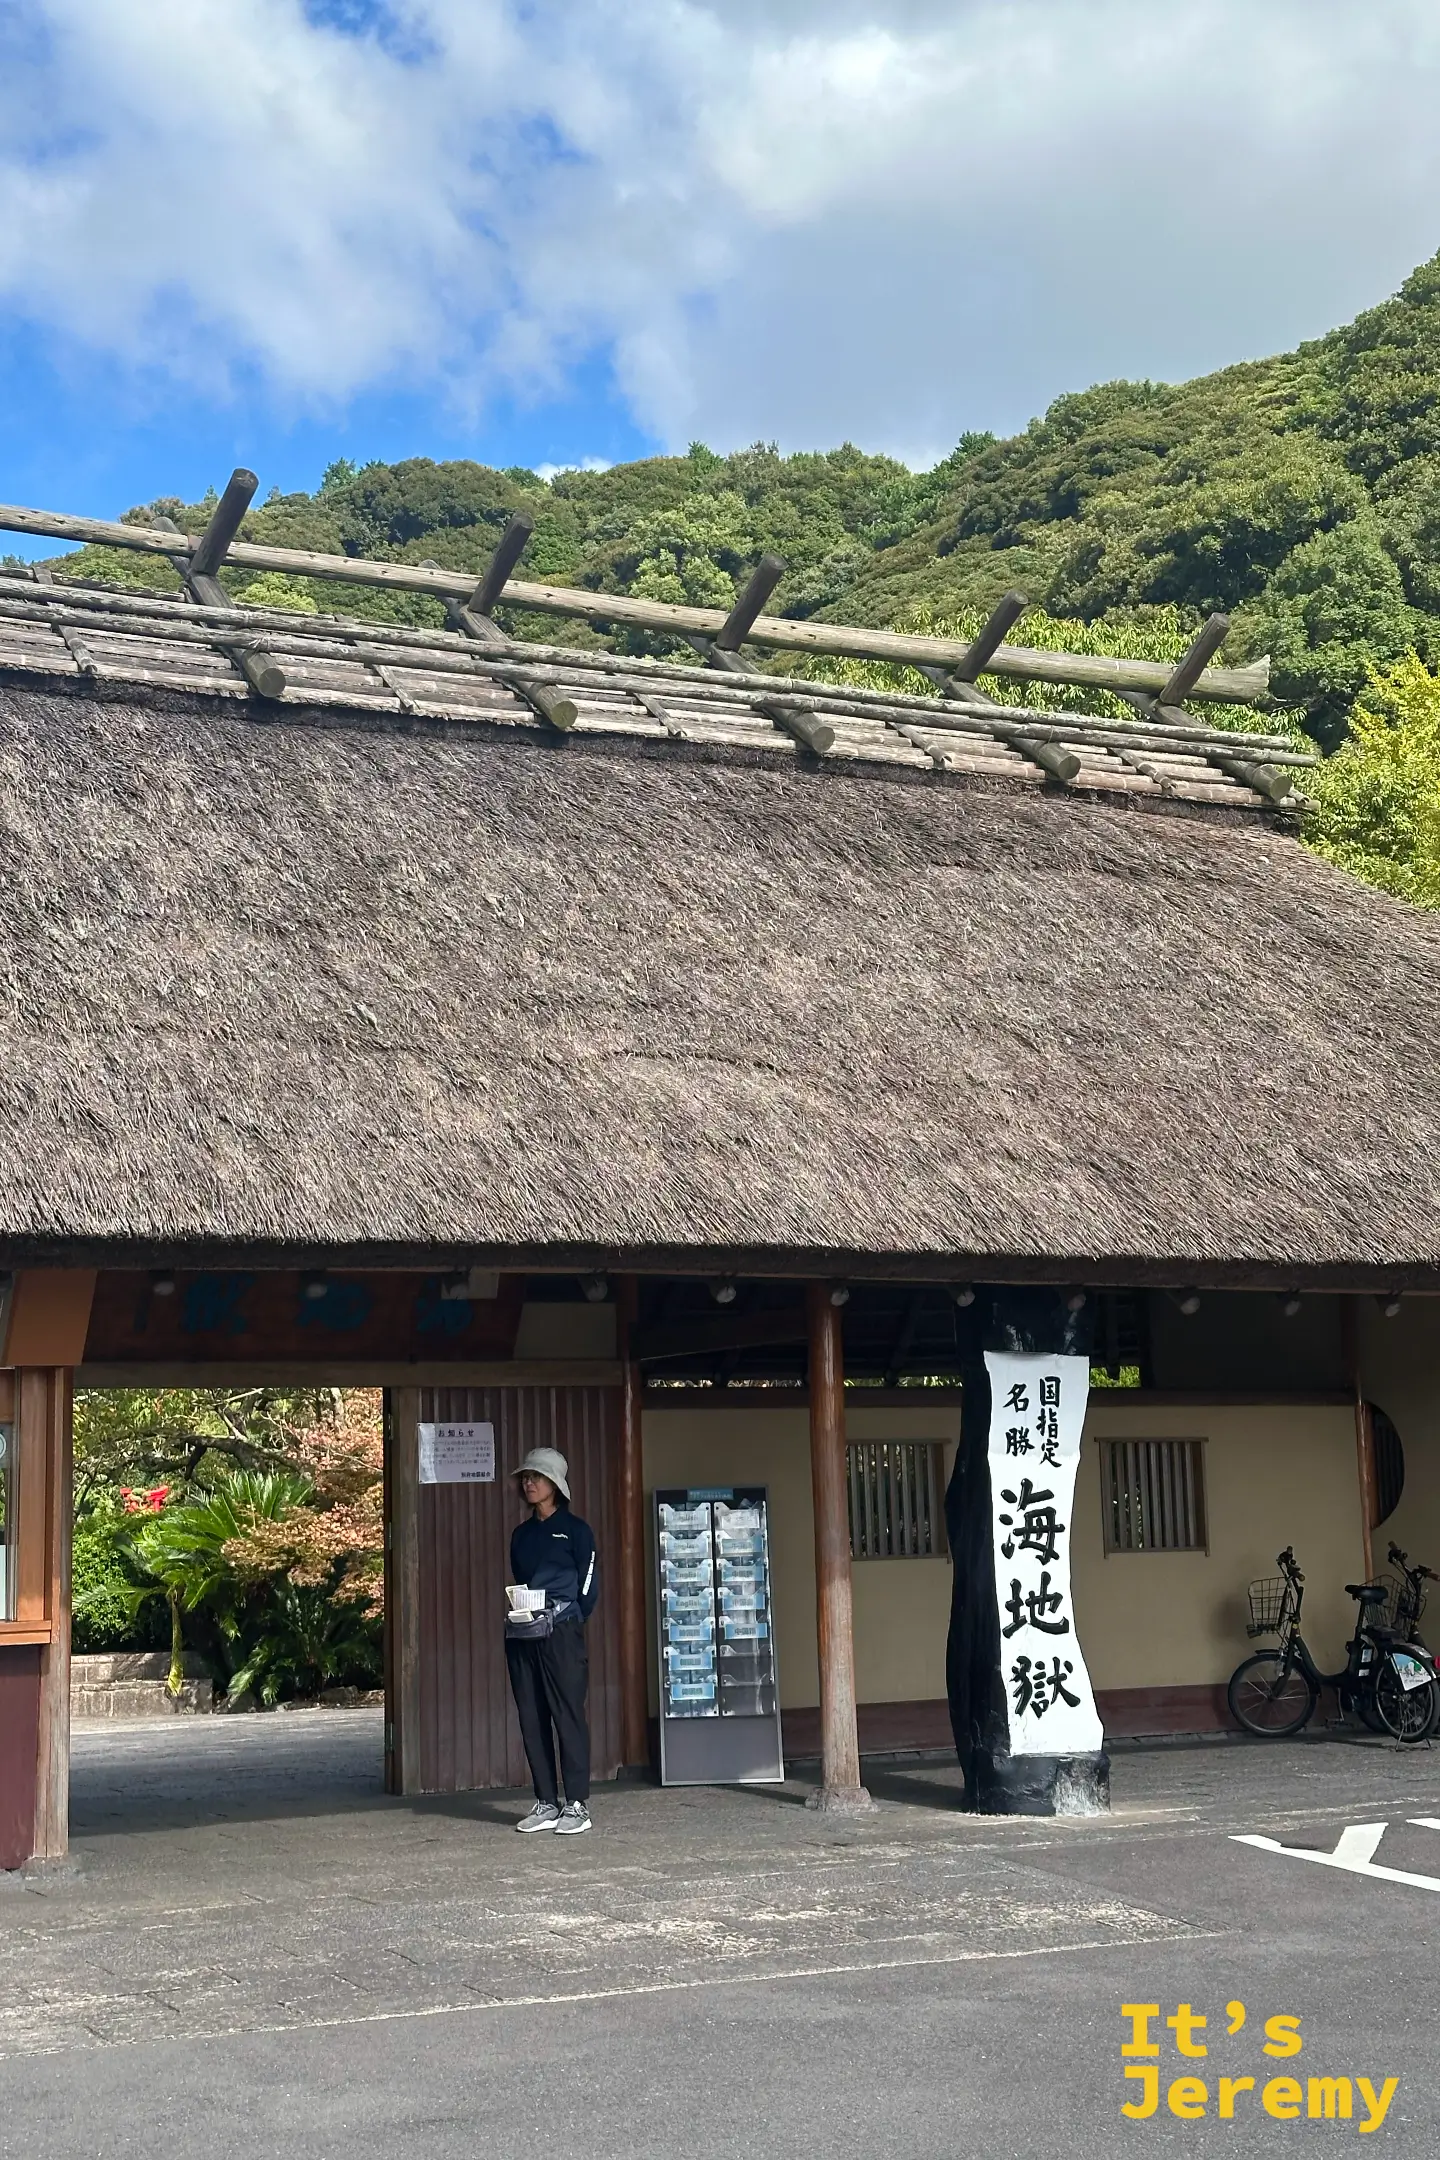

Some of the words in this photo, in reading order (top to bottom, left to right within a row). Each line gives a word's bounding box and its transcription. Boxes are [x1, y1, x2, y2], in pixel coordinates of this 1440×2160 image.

[438, 1428, 475, 1437] お知らせ
[1003, 1383, 1035, 1457] 名勝
[1036, 1376, 1062, 1468] 国指定
[999, 1478, 1081, 1718] 海地獄
